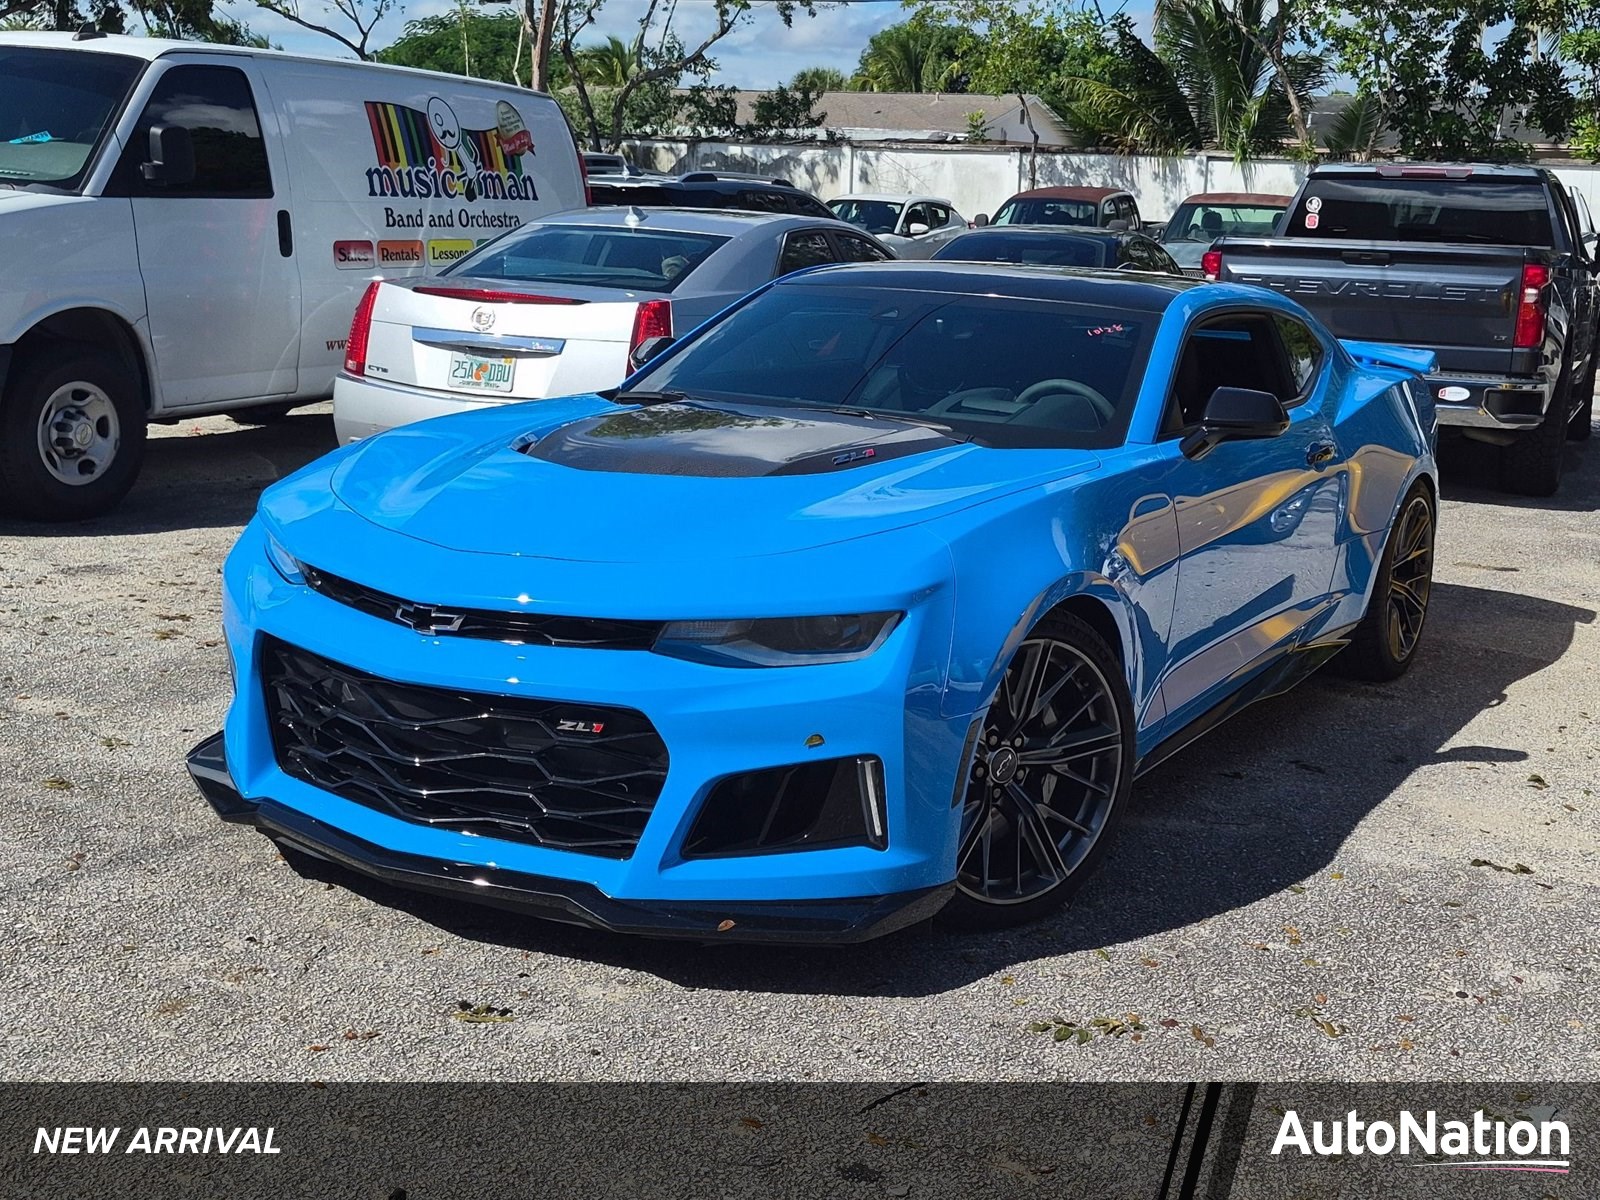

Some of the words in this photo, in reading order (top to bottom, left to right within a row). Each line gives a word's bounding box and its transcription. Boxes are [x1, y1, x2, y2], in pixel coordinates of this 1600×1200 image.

[365, 157, 457, 199] music
[481, 171, 539, 201] man
[384, 207, 424, 228] Band
[428, 209, 454, 228] and
[458, 209, 520, 228] Orchestra
[338, 248, 369, 262] Sales
[381, 247, 420, 261] Rentals
[452, 360, 473, 379] 25A
[488, 363, 511, 382] DBU
[831, 448, 875, 465] ZL1
[556, 718, 604, 733] ZL1
